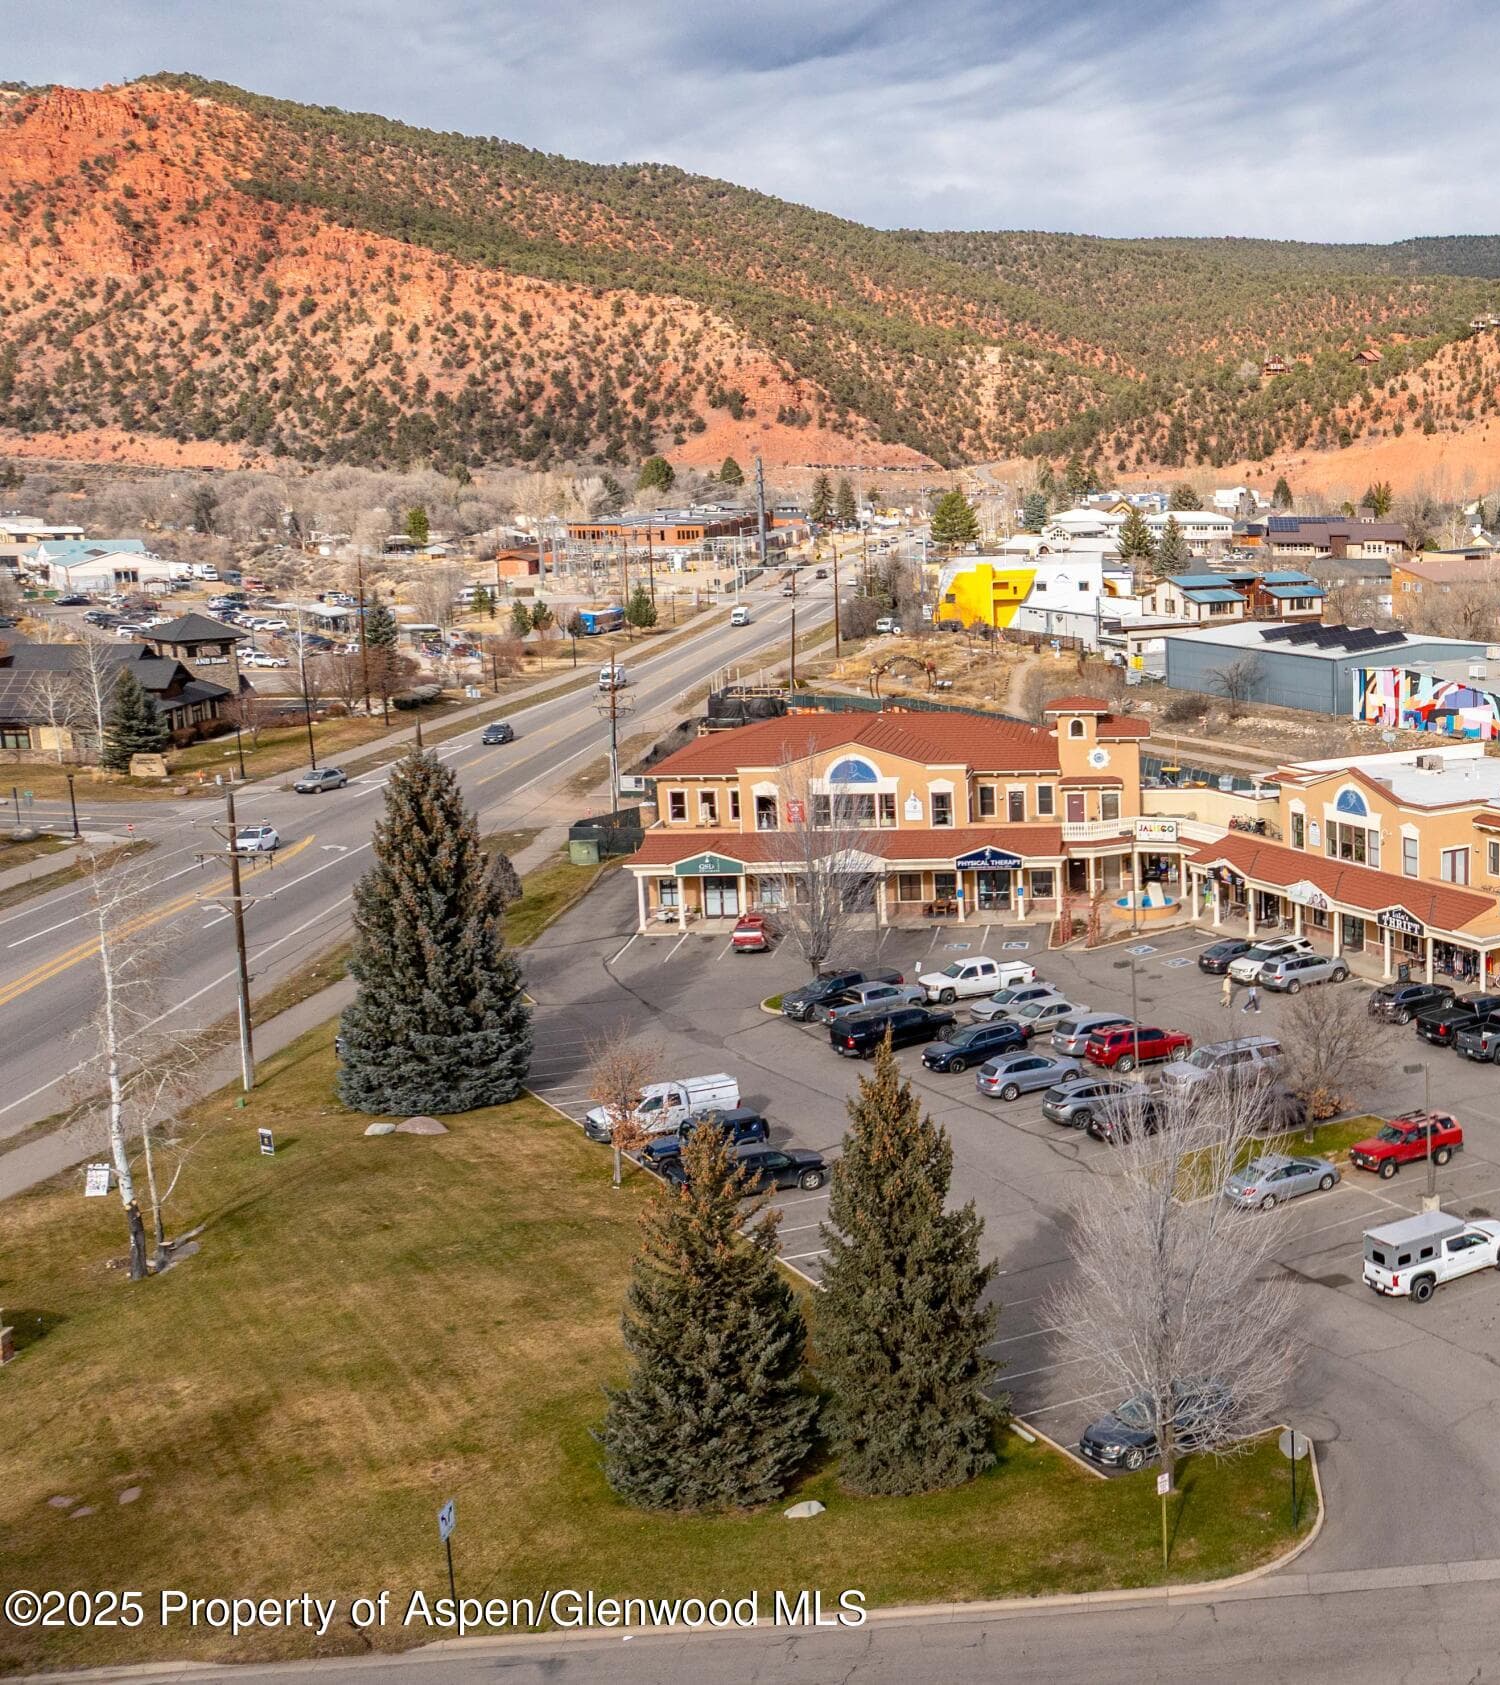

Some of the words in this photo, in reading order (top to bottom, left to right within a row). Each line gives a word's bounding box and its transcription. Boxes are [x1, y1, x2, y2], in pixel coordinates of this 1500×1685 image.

[957, 859, 989, 867] PHYSICAL
[991, 858, 1020, 866] THERAPY
[1382, 914, 1420, 935] THRIFT
